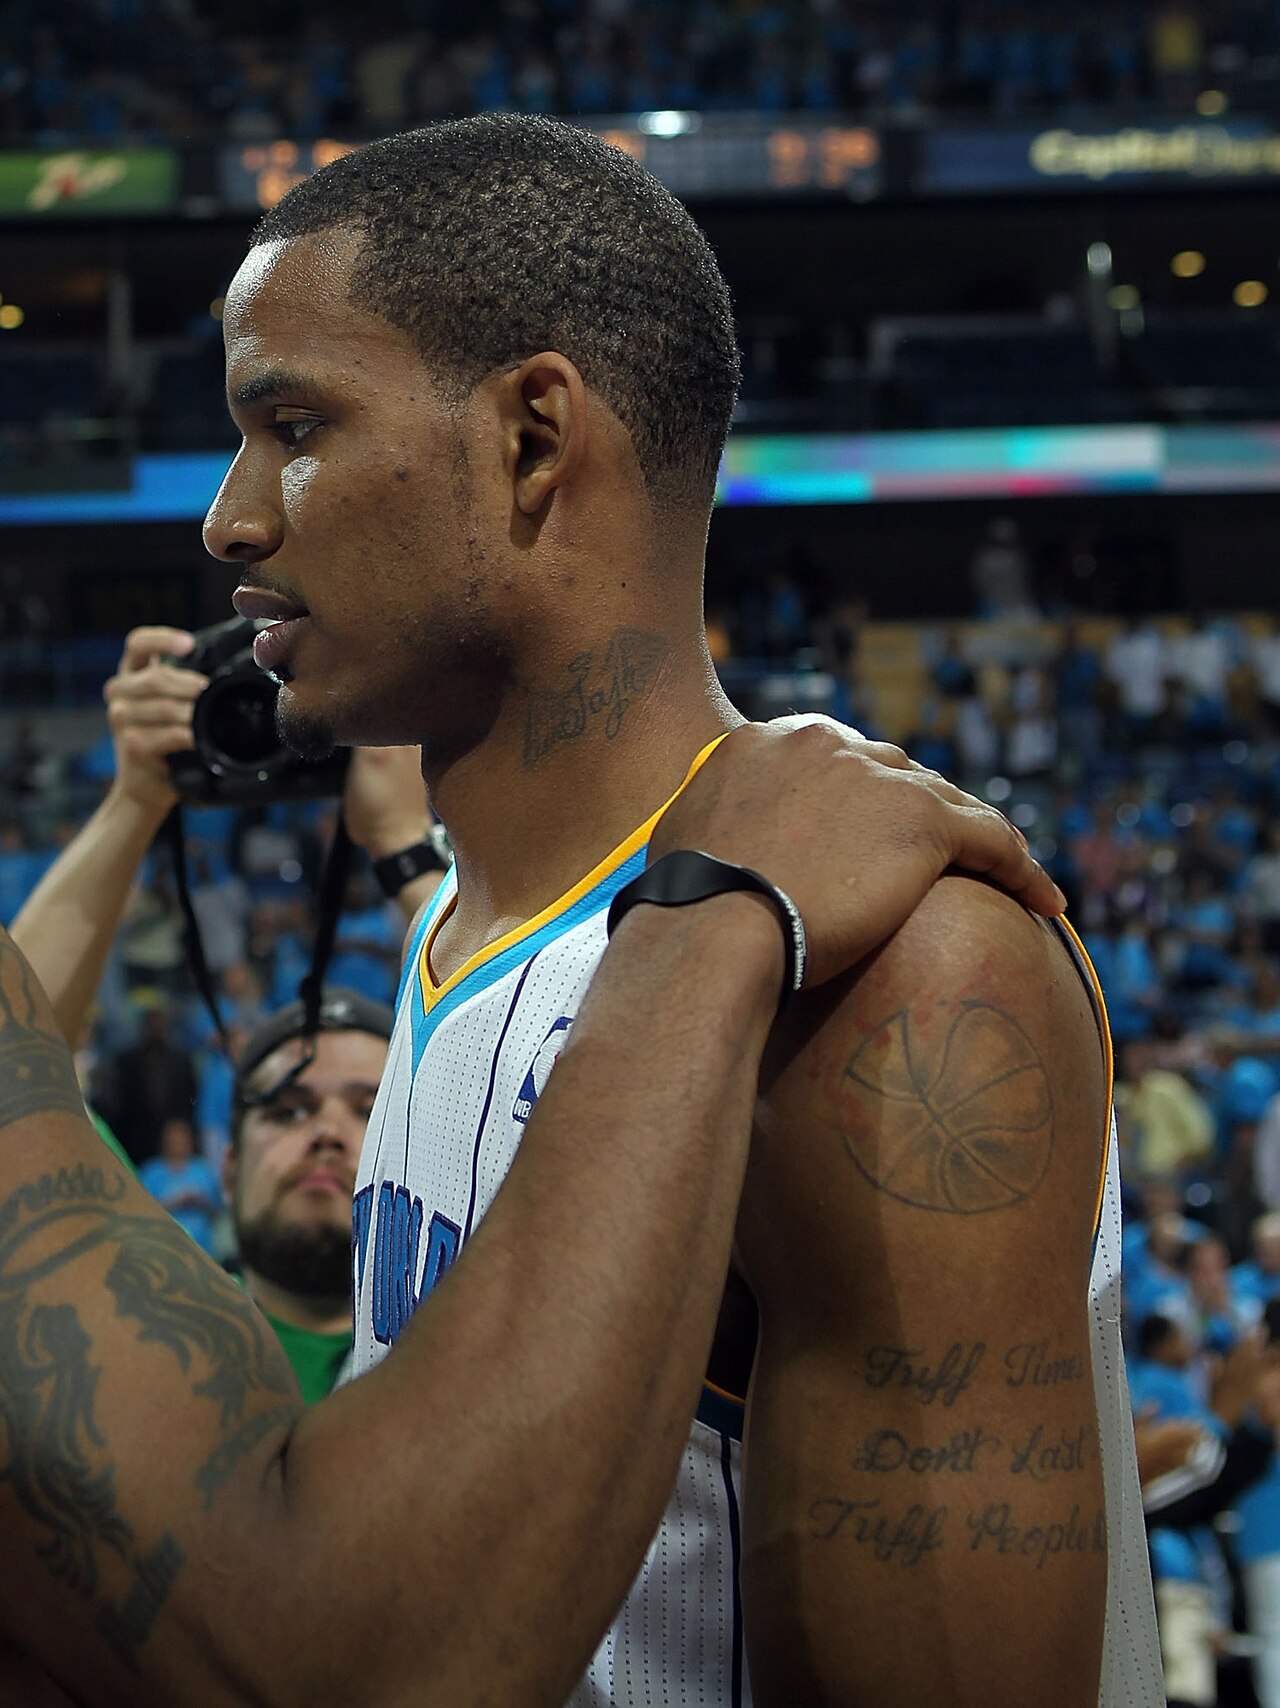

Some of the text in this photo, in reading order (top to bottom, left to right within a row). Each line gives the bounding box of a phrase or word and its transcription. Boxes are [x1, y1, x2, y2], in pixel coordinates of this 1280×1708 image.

[512, 1096, 533, 1119] NB
[864, 1341, 987, 1406] Tuff
[807, 1498, 949, 1567] Tuff
